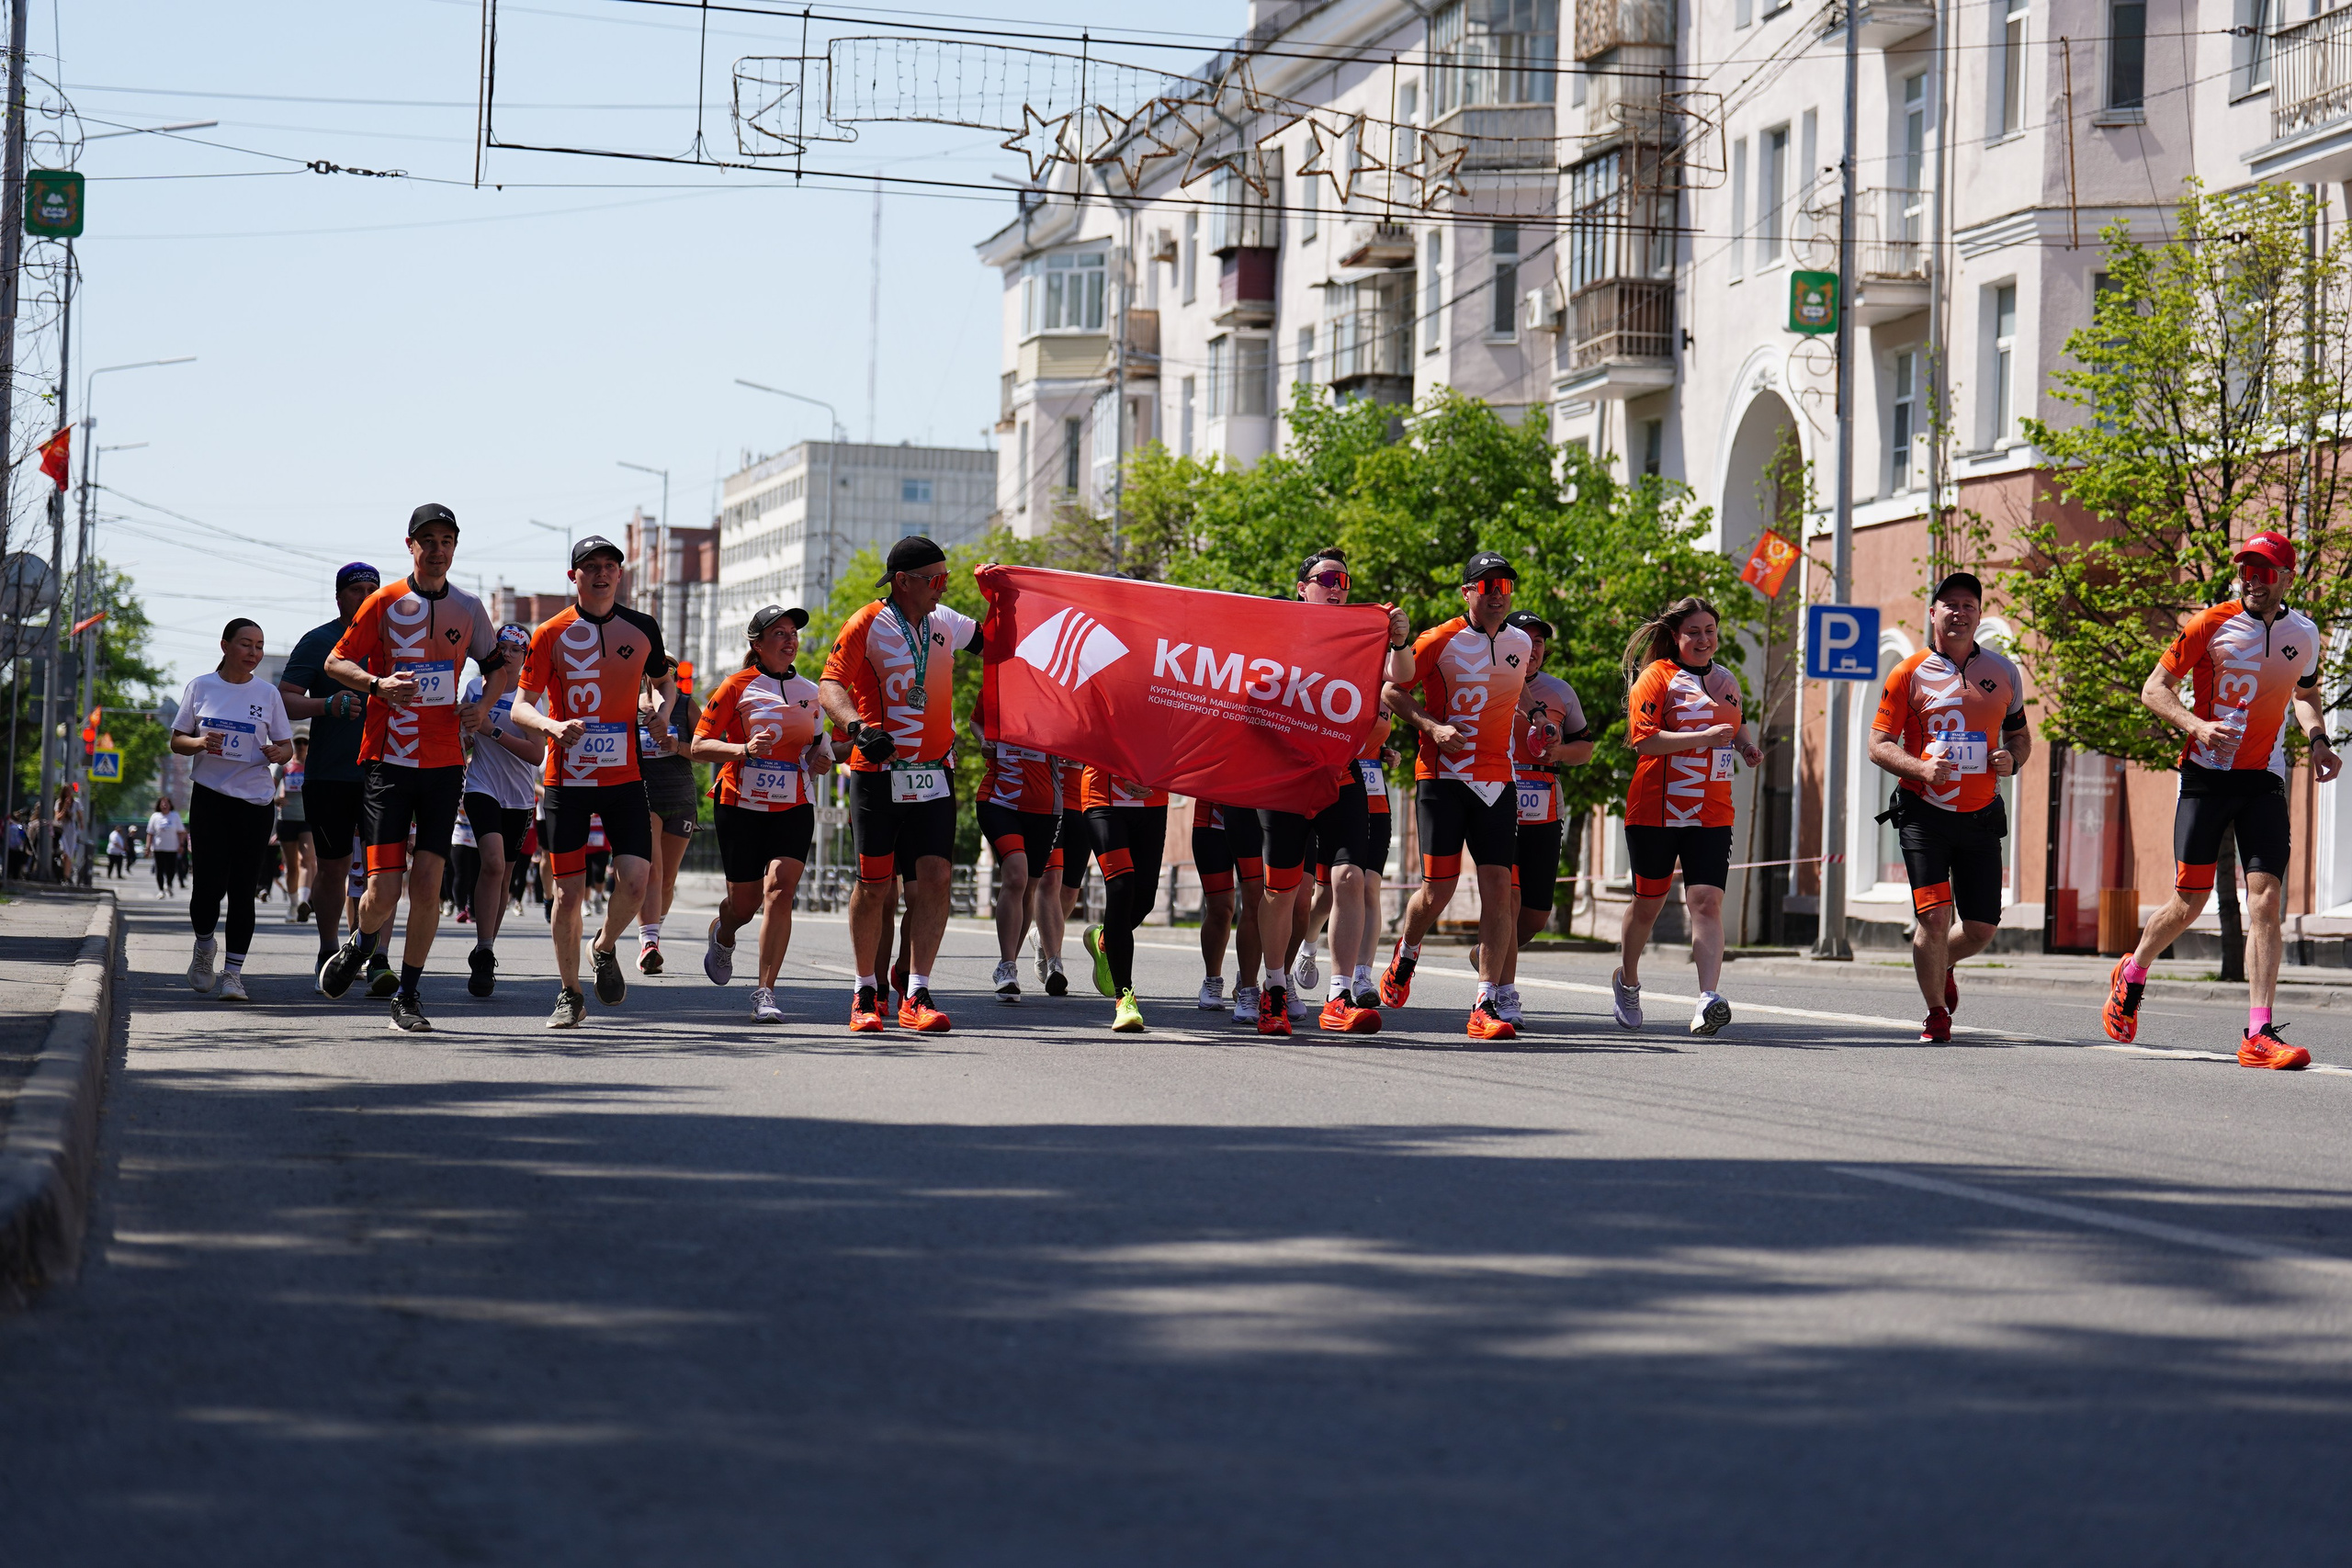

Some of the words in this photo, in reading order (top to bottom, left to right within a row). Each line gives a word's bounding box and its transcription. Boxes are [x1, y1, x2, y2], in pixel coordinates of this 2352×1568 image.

[1819, 613, 1860, 671] P
[412, 676, 440, 693] 99
[1153, 637, 1362, 724] КМЗКО
[1148, 694, 1220, 717] КОНВЕЙЕРНОГО
[1222, 712, 1291, 734] ОБОРУДОВАНИЯ
[1149, 684, 1206, 704] КУРГАНСКИЙ
[1209, 698, 1318, 733] МАШИНОСТРОИТЕЛЬНЫЙ
[1320, 727, 1351, 743] ЗАВОД
[583, 737, 615, 753] 602
[1946, 745, 1973, 761] 611
[756, 773, 786, 789] 594
[906, 773, 934, 789] 120
[1520, 794, 1539, 807] 00
